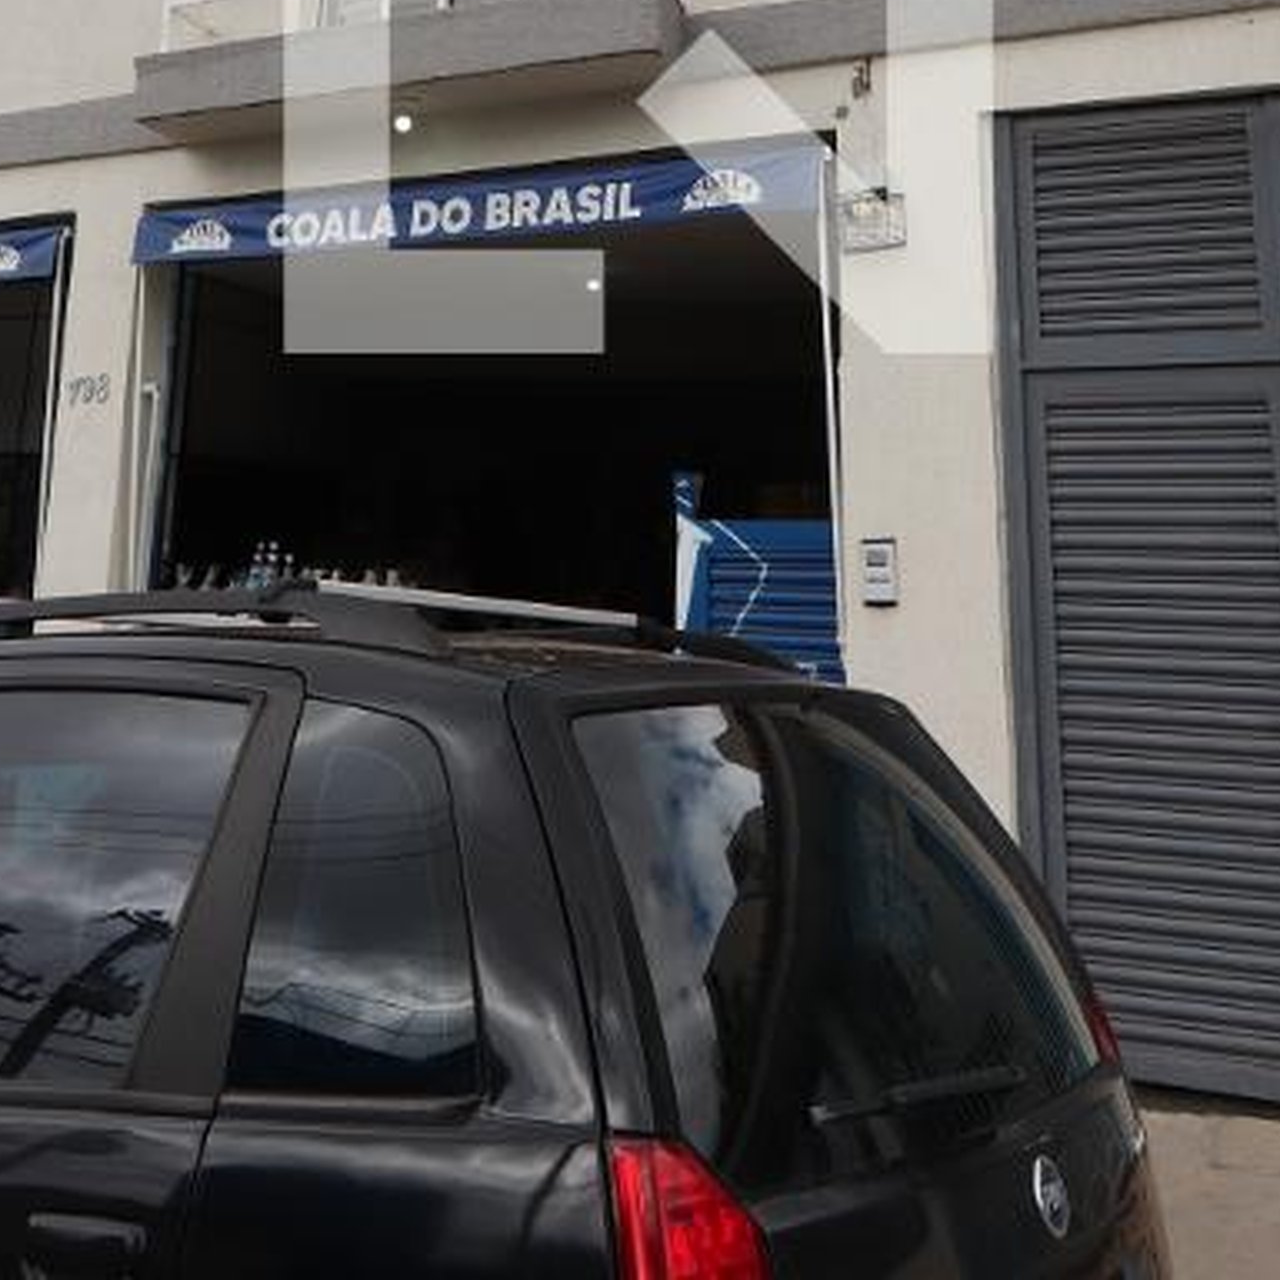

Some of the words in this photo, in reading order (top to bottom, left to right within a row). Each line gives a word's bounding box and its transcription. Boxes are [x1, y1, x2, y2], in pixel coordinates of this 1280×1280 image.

[266, 201, 397, 248] COALA
[408, 196, 474, 237] DO
[483, 181, 643, 231] BRASIL
